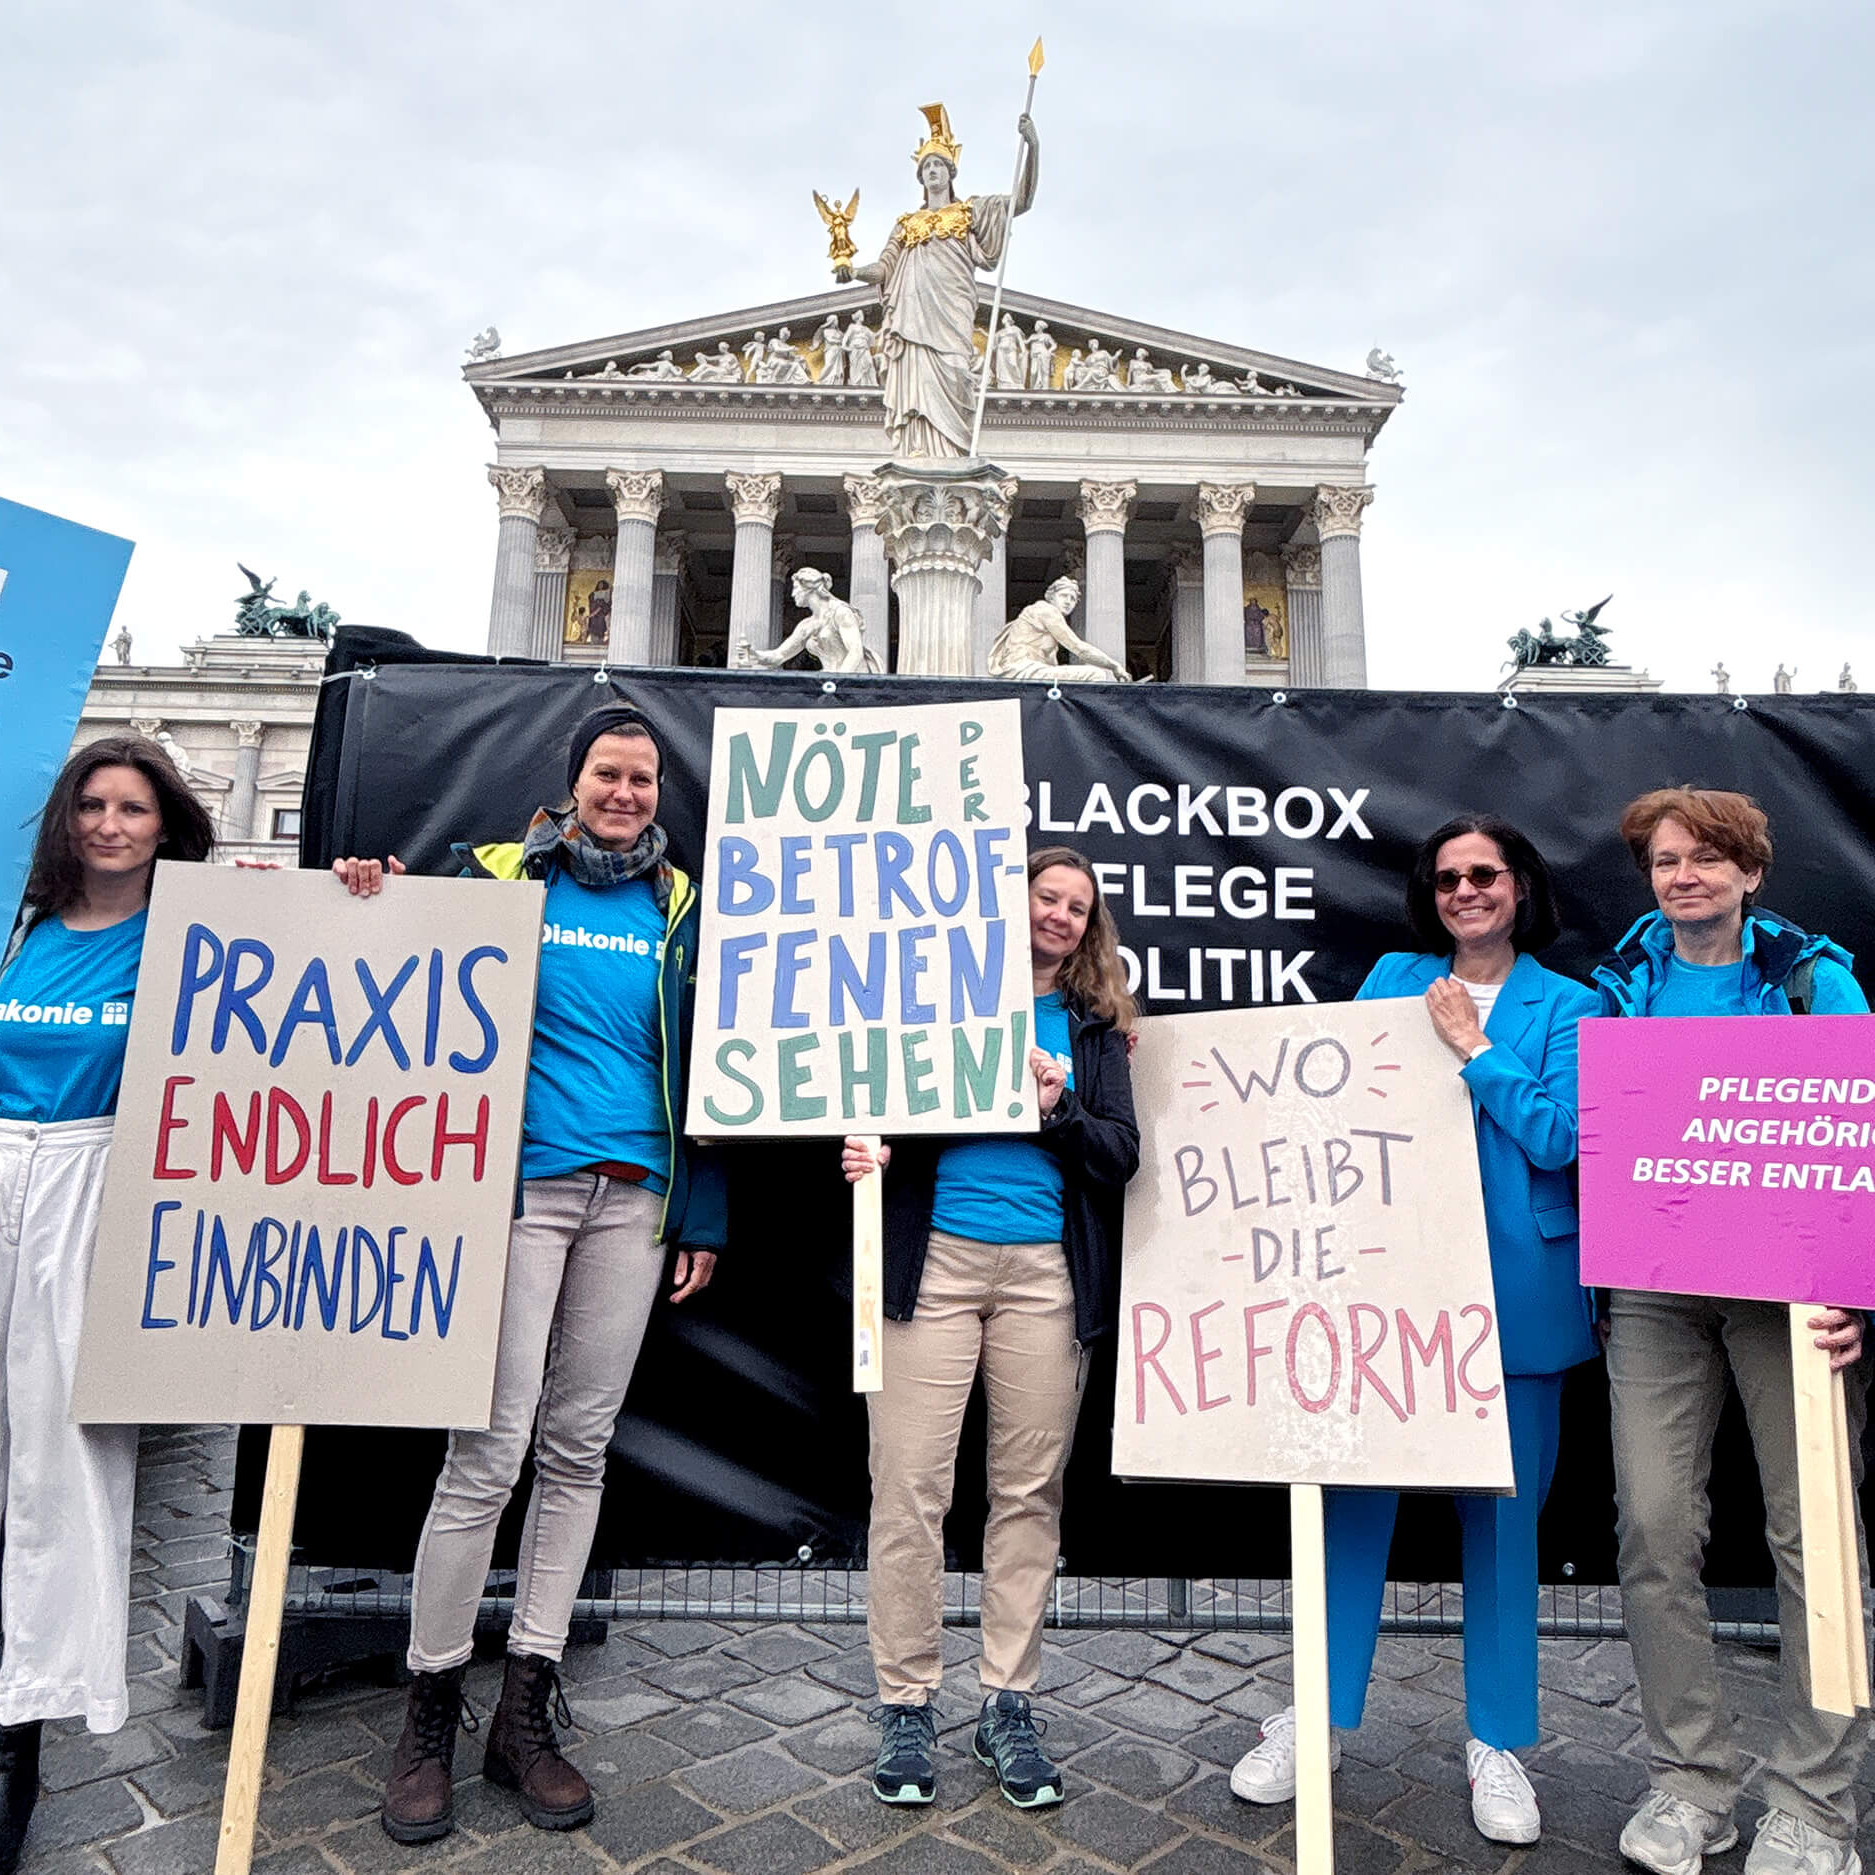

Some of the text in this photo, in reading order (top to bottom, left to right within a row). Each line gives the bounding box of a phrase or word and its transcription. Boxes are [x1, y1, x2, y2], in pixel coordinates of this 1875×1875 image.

[725, 721, 932, 824] NÖTE
[960, 721, 990, 822] DER
[1023, 781, 1374, 839] LACKBOX
[718, 827, 1024, 919] BETROF-
[172, 923, 508, 1074] PRAXIS
[718, 919, 1006, 1029] FENEN
[703, 1011, 1027, 1126] SEHEN!
[1210, 1037, 1351, 1103] WO
[1699, 1077, 1875, 1104] PFLEGEND
[153, 1076, 490, 1188] ENDLICH
[1174, 1128, 1414, 1217] BLEIBT
[1632, 1157, 1875, 1193] BESSER ENTLA
[1681, 1115, 1875, 1148] ANGEHÖRI
[141, 1200, 463, 1341] EINBINDEN
[1132, 1298, 1500, 1425] REFORM?
